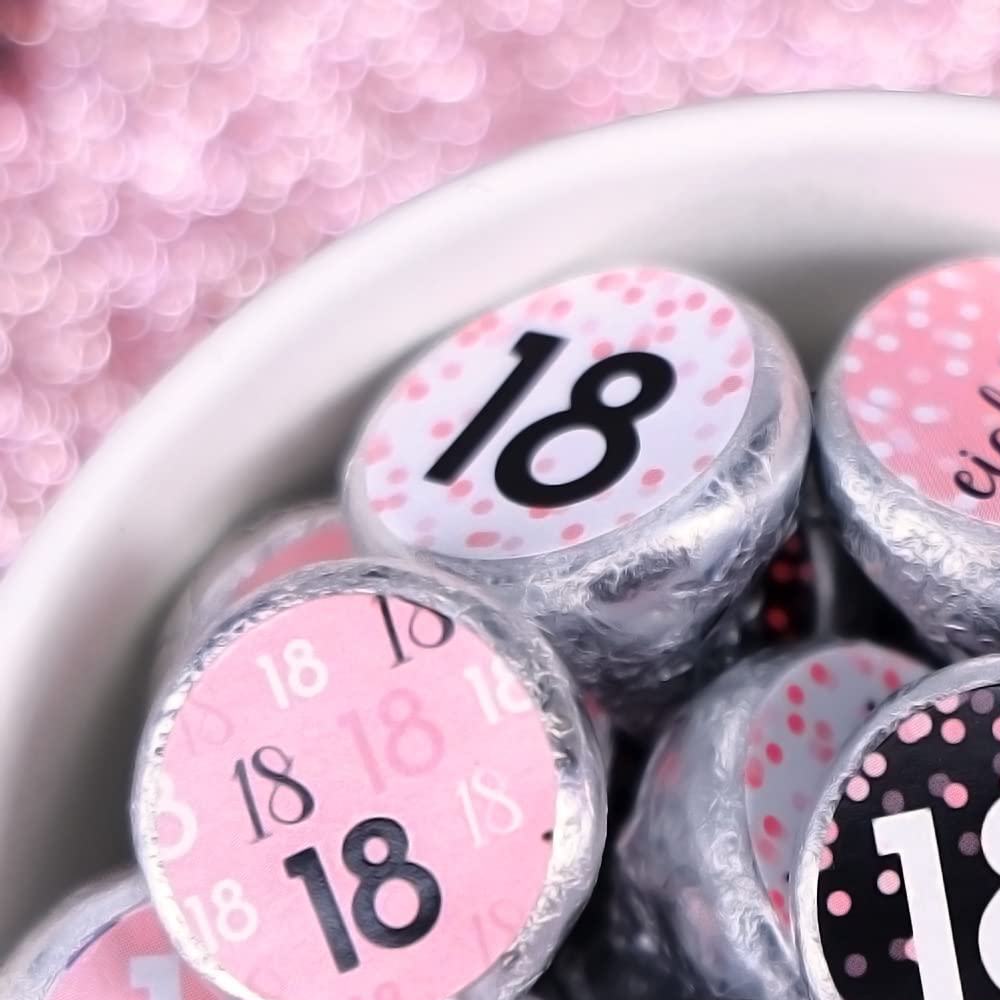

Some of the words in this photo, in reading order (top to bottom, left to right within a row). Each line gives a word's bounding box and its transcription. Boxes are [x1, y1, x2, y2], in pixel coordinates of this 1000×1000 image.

[424, 330, 677, 509] 18
[257, 638, 328, 709] 18
[338, 687, 446, 794] 18
[231, 745, 316, 845] 18
[457, 767, 524, 849] 18
[185, 879, 258, 955] 18
[283, 817, 442, 973] 18
